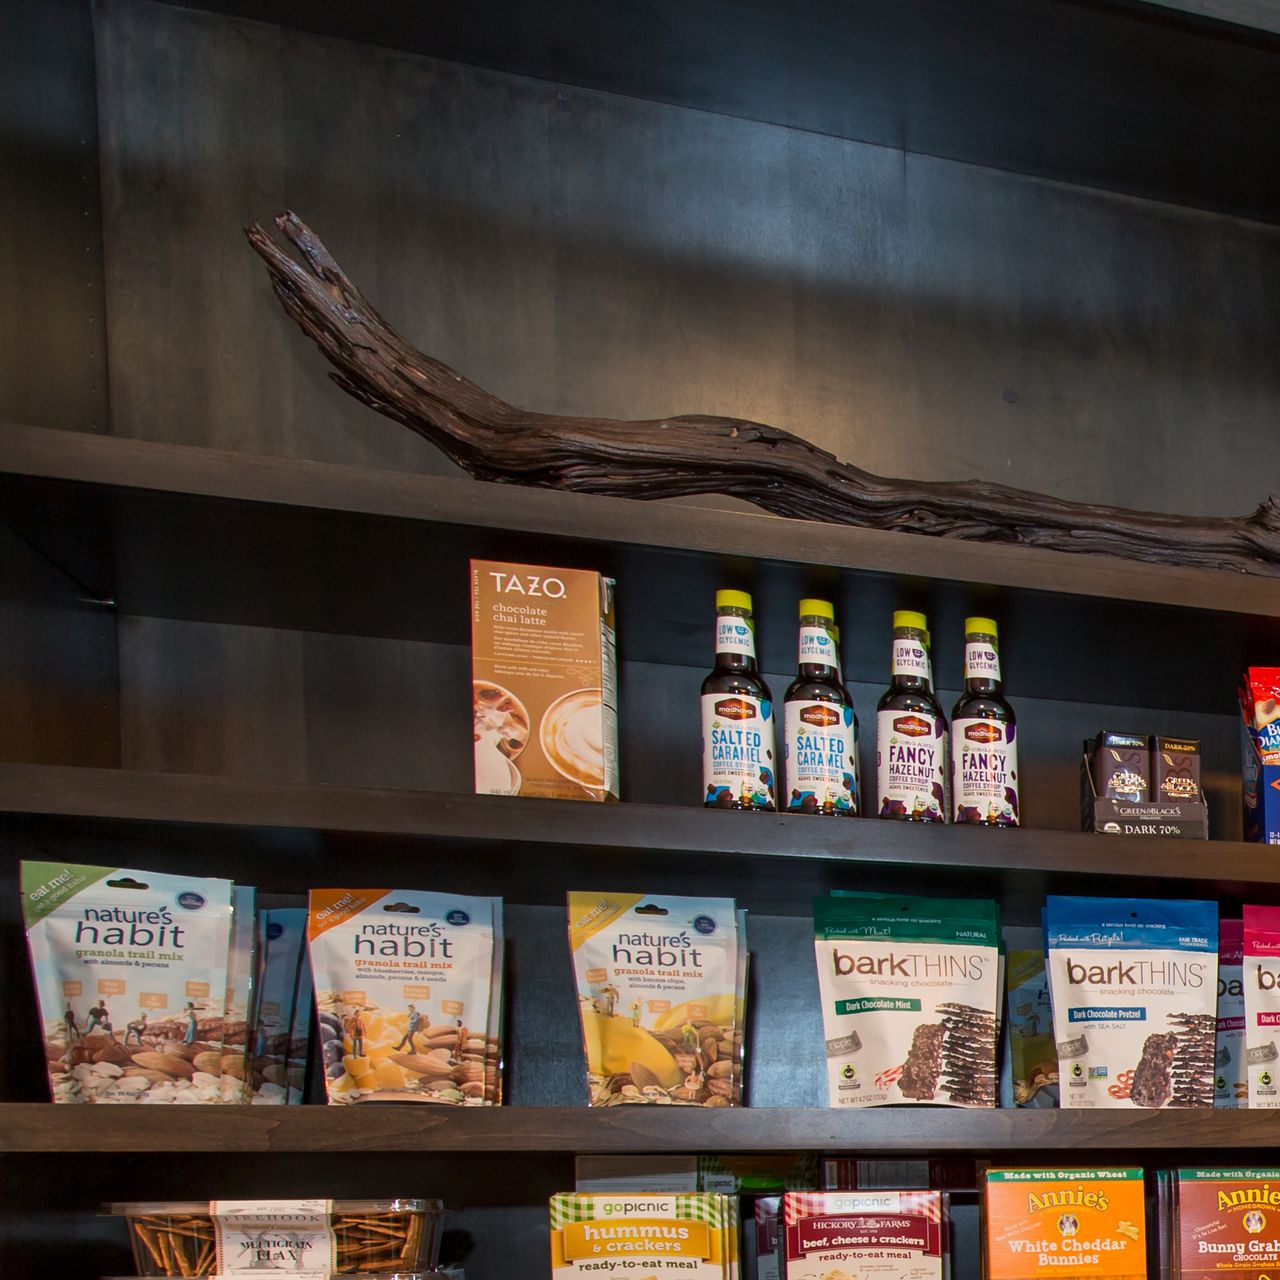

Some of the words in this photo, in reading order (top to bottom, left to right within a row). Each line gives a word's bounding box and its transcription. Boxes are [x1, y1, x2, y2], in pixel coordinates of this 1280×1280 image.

[493, 604, 547, 616] chocolate
[493, 613, 517, 623] chai
[521, 615, 546, 626] latte
[896, 647, 910, 658] LOW
[969, 650, 983, 661] LOW
[712, 730, 761, 747] SALTED
[797, 736, 844, 753] SALTED
[713, 745, 762, 764] CARAMEL
[797, 751, 845, 769] CARAMEL
[889, 745, 935, 769] FANCY
[963, 753, 1007, 772] FANCY
[889, 764, 934, 780] HAZELNUT
[963, 771, 1007, 784] HAZELNUT
[1125, 826, 1156, 834] DARK
[1160, 826, 1180, 834] 70%
[84, 906, 173, 925] nature's
[75, 921, 185, 948] habit
[363, 922, 442, 937] nature's
[619, 931, 691, 947] nature's
[355, 935, 453, 958] habit
[75, 949, 124, 959] granola
[128, 950, 155, 959] trail
[158, 952, 184, 961] mix
[612, 945, 702, 967] habit
[355, 959, 400, 968] granola
[403, 960, 427, 968] trail
[431, 961, 453, 969] mix
[833, 949, 983, 981] barkTHINS
[614, 967, 654, 976] granola
[1067, 958, 1203, 988] barkTHINS
[846, 1002, 860, 1011] Dark
[862, 1000, 894, 1009] Chocolate
[896, 1001, 911, 1009] Mint
[1074, 1010, 1086, 1018] Dark
[1087, 1010, 1117, 1018] Chocolate
[1261, 1015, 1275, 1023] Dark
[1027, 1185, 1110, 1214] Annie's
[603, 1202, 669, 1214] gopicnic
[813, 1221, 857, 1230] HICKORY
[880, 1220, 911, 1228] FARMS
[584, 1226, 689, 1240] hummus
[240, 1240, 313, 1250] MULTIGRAIN
[592, 1243, 601, 1252] &
[607, 1240, 681, 1252] crackers
[803, 1238, 829, 1248] beef,
[832, 1236, 869, 1245] cheese
[880, 1236, 925, 1246] crackers
[1008, 1241, 1057, 1253] White
[1062, 1239, 1126, 1251] Cheddar
[1198, 1241, 1245, 1254] Bunny
[819, 1251, 884, 1261] ready-to-eat
[1038, 1254, 1099, 1266] Bunnies
[579, 1260, 662, 1271] ready-to-eat
[666, 1260, 698, 1269] meal
